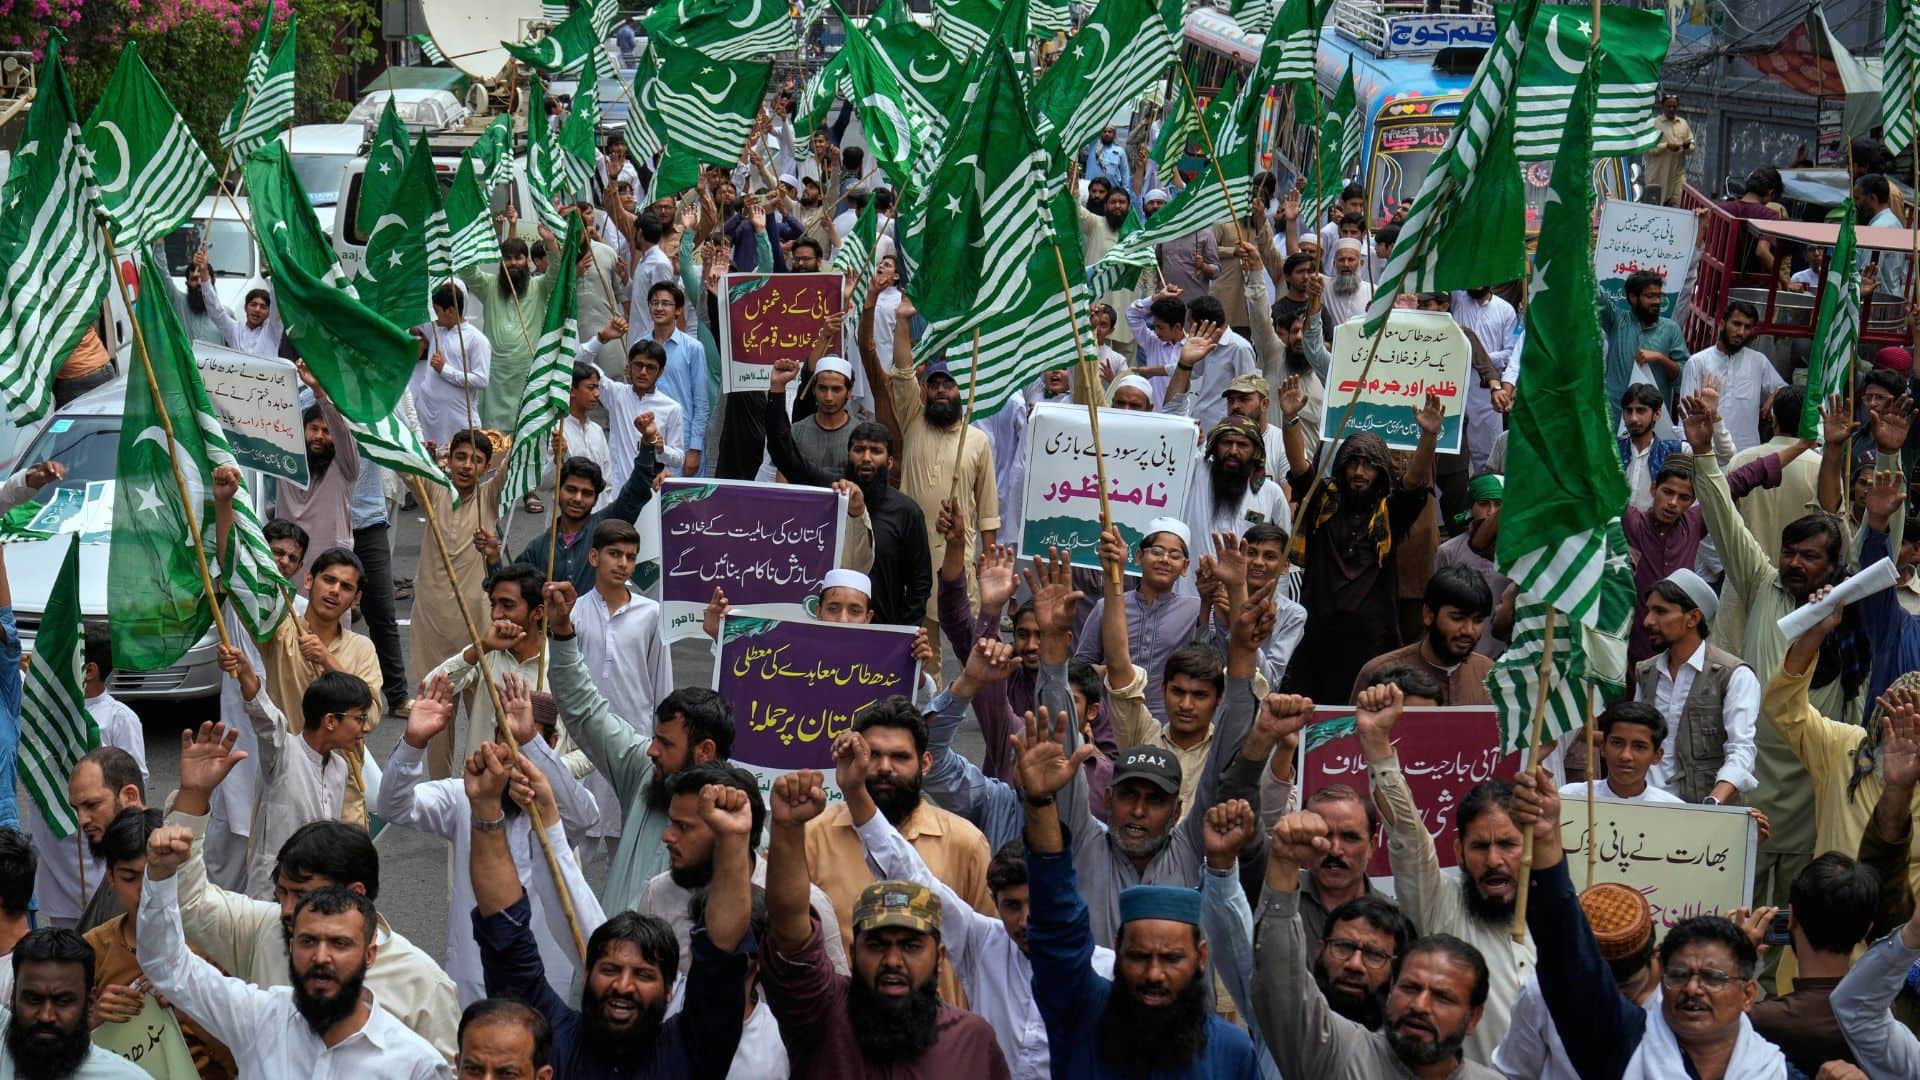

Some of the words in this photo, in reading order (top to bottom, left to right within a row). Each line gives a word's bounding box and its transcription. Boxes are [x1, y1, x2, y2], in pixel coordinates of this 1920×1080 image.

[1391, 22, 1449, 46] کوچ
[1616, 213, 1637, 232] نہیں
[1661, 219, 1674, 246] پانی
[1651, 228, 1660, 242] پر
[744, 289, 787, 320] دشمنوں
[788, 287, 810, 313] کے
[743, 322, 763, 352] یکجا
[759, 326, 779, 356] قوم
[780, 333, 812, 347] خلاف
[1384, 328, 1398, 338] معا
[1398, 328, 1422, 342] طاس
[1422, 332, 1448, 343] سندھ
[1351, 346, 1378, 363] وزی
[1379, 350, 1408, 364] خلاف
[1409, 349, 1430, 368] طرفہ
[1428, 352, 1451, 372] یک
[217, 364, 239, 375] سندھ
[239, 362, 255, 379] نے
[255, 371, 285, 387] بھارت
[230, 385, 257, 402] کرنے
[1369, 378, 1401, 395] جرم
[1401, 377, 1424, 397] اور
[1426, 380, 1457, 397] ظلم
[257, 387, 269, 411] ختم
[1045, 431, 1081, 460] بازی
[1082, 443, 1139, 460] سودے
[1151, 434, 1176, 476] پانی
[1134, 449, 1149, 470] پر
[1043, 474, 1168, 508] نامنظور
[671, 518, 705, 535] خلاف
[702, 513, 727, 536] کے
[728, 520, 772, 541] سالمیت
[772, 518, 795, 544] کی
[787, 521, 830, 551] پاکستان
[669, 546, 698, 577] گے
[700, 552, 740, 582] بنائیں
[741, 557, 774, 588] ناکام
[774, 553, 817, 585] سازش
[671, 613, 695, 628] لاہور
[733, 646, 772, 677] معطلی
[760, 643, 791, 680] کی
[779, 660, 835, 687] معاہدے
[834, 663, 870, 686] طاس
[869, 671, 901, 687] سندھ
[776, 712, 796, 746] پر
[797, 698, 878, 743] کستان
[1127, 753, 1166, 769] DRAX
[1322, 754, 1368, 775] لاف
[1404, 751, 1471, 783] جارحیت
[1470, 746, 1500, 782] آبی
[1600, 821, 1630, 873] پانی
[1629, 833, 1663, 861] نے
[1666, 843, 1730, 872] بھارت
